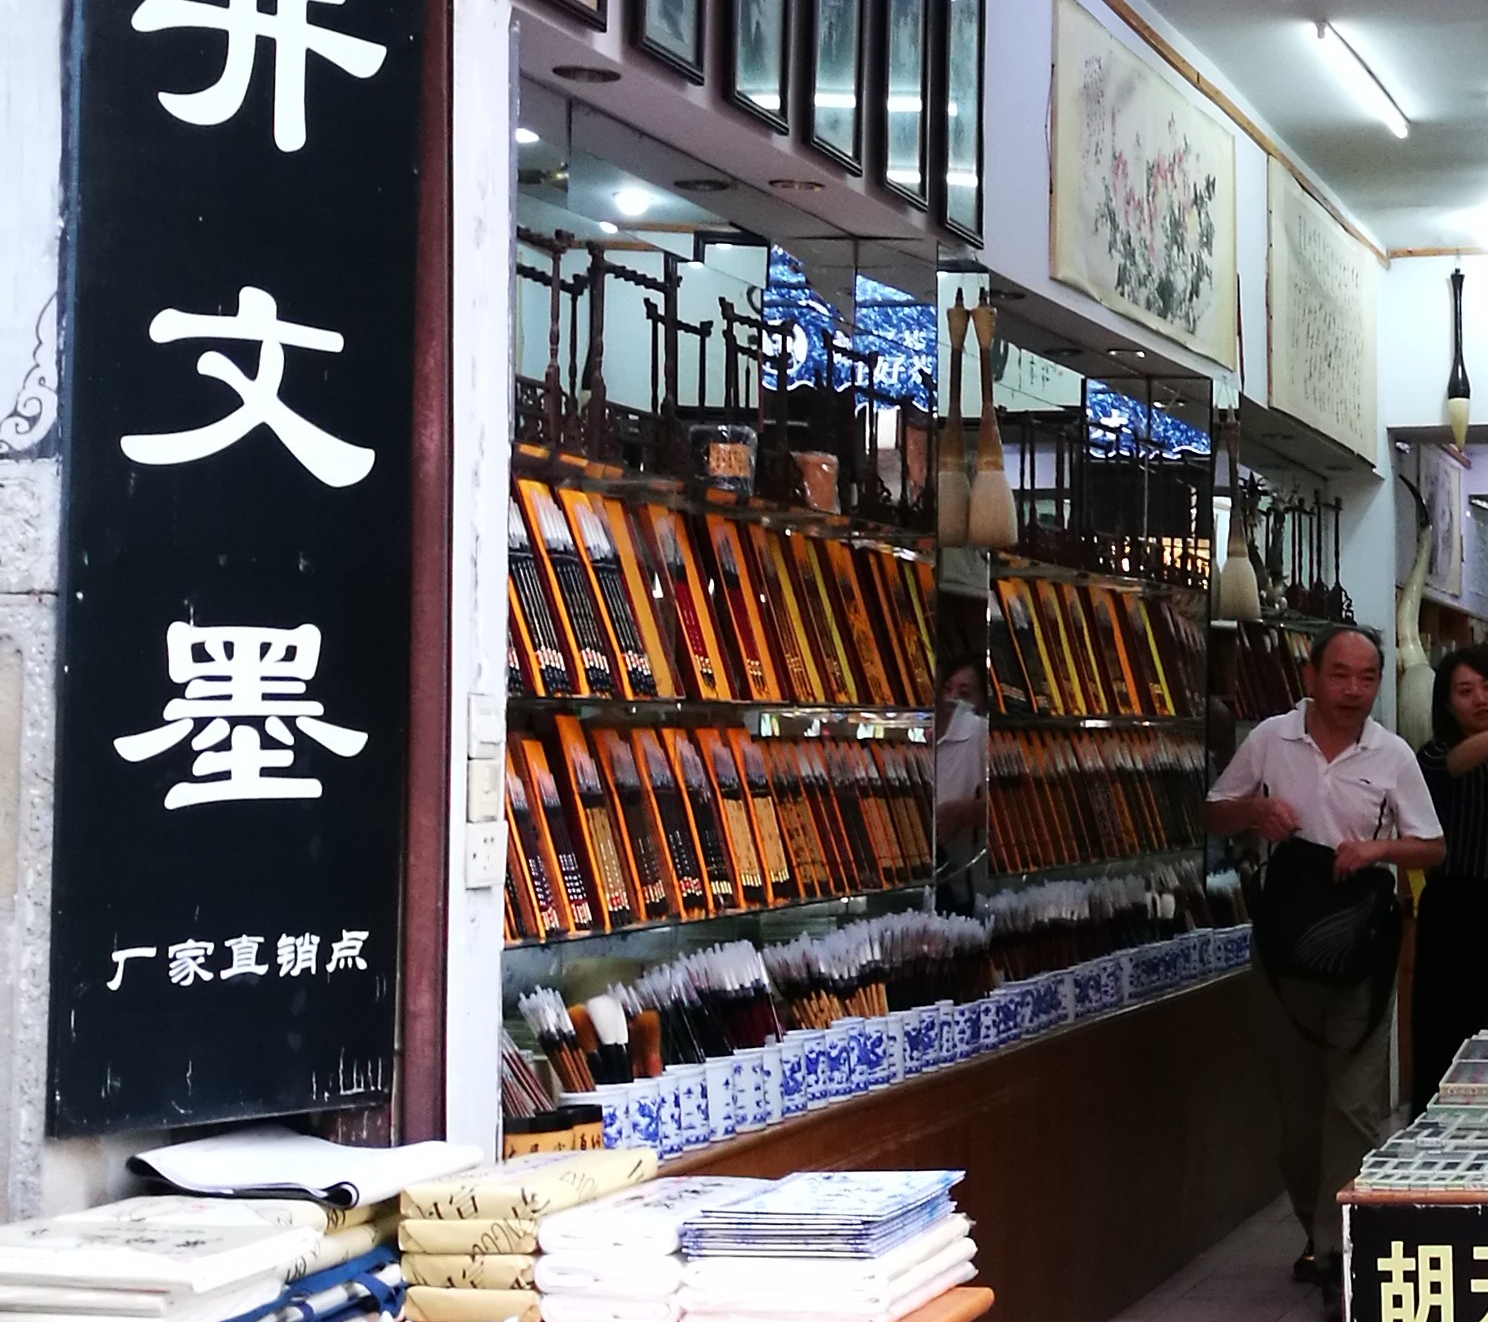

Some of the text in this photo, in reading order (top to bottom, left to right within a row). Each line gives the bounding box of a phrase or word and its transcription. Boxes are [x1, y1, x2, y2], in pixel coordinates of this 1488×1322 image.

[106, 929, 370, 991] 厂家直销点
